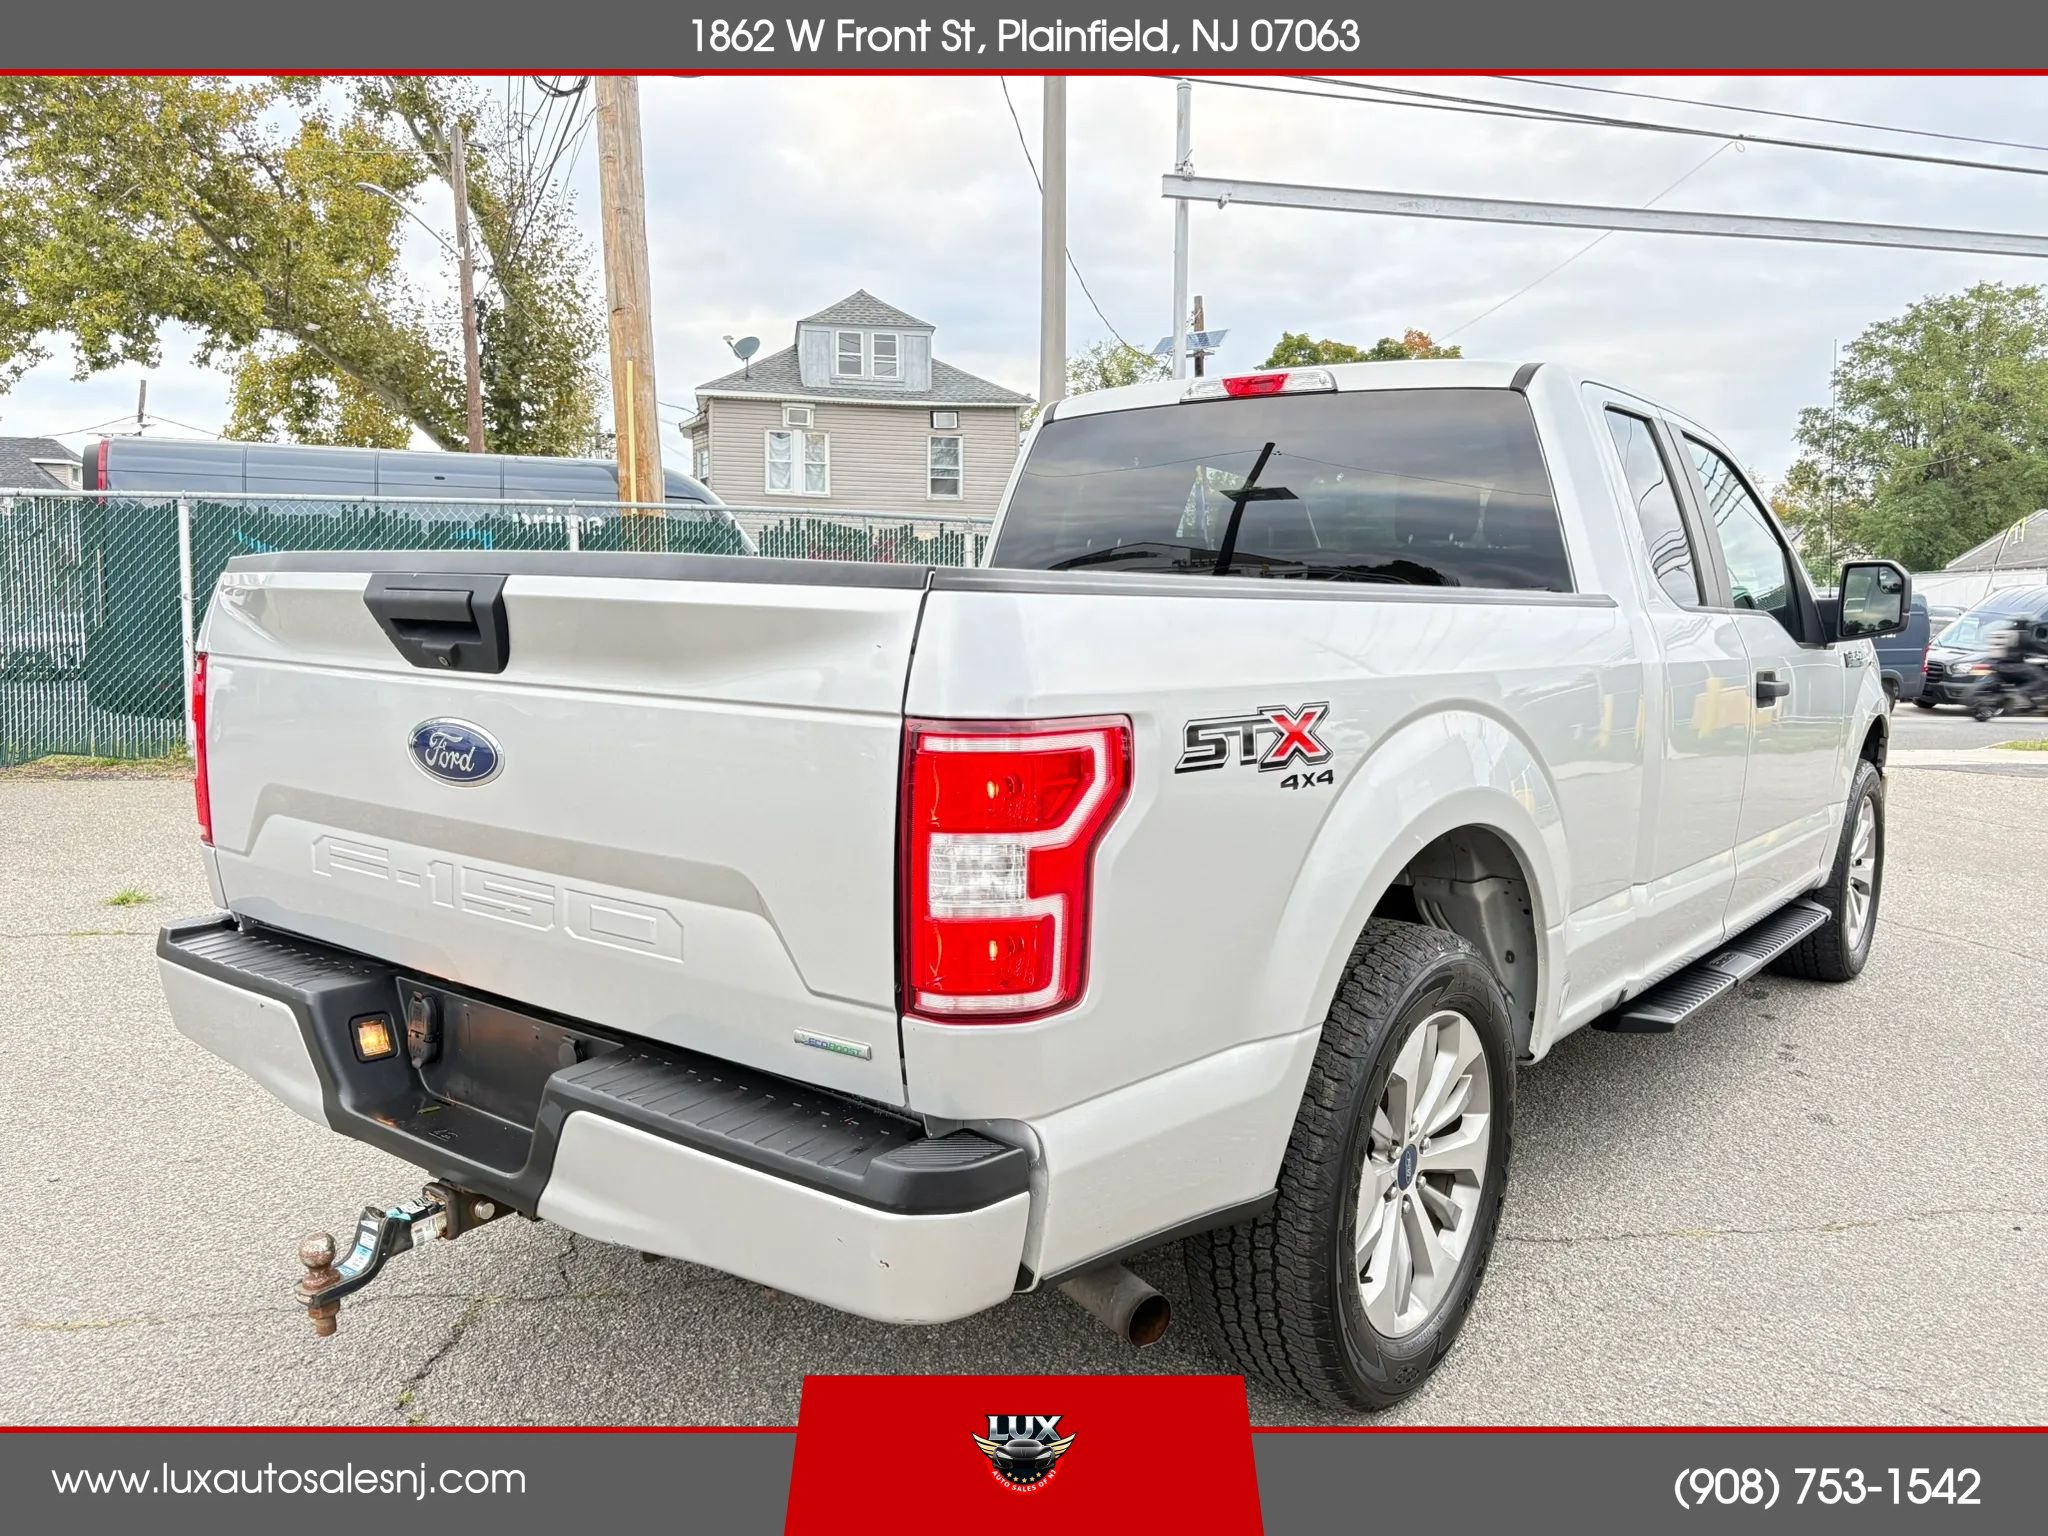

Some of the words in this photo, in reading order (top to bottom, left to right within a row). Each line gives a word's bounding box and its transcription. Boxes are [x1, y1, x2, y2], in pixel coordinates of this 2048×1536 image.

[425, 731, 476, 772] Ford
[1175, 701, 1334, 773] STX
[311, 834, 684, 964] F-150
